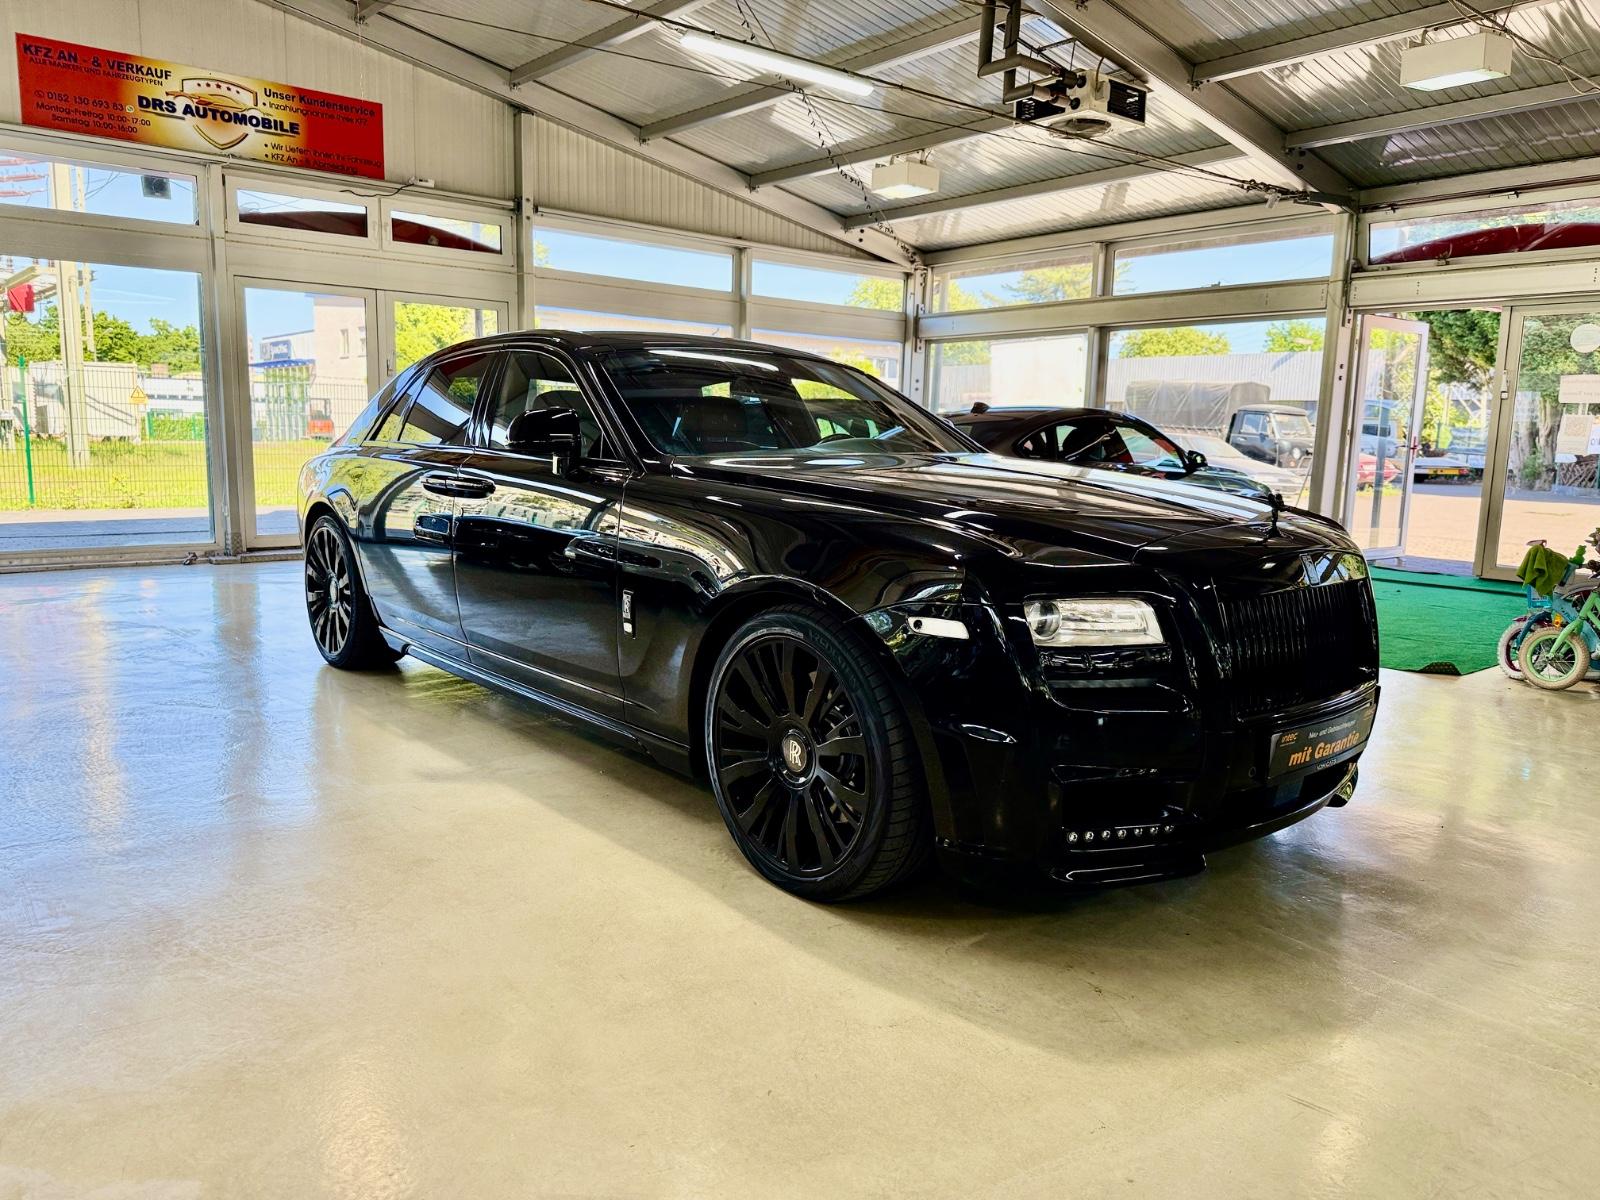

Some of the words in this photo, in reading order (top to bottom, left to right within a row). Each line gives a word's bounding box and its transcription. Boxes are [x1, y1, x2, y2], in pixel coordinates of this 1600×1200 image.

[23, 43, 52, 59] KFZ
[57, 50, 78, 64] AN
[91, 56, 101, 68] &
[107, 59, 172, 81] VERKAUF
[102, 70, 163, 87] FAHRZEUGTYPEN
[137, 95, 177, 114] DRS
[182, 103, 300, 135] AUTOMOBILE
[263, 87, 297, 103] Unser
[299, 95, 376, 118] Kundenservice
[271, 141, 284, 152] Wir
[271, 152, 285, 162] KFZ
[287, 155, 297, 164] An
[1289, 746, 1313, 766] mit
[1314, 731, 1360, 759] Garantie
